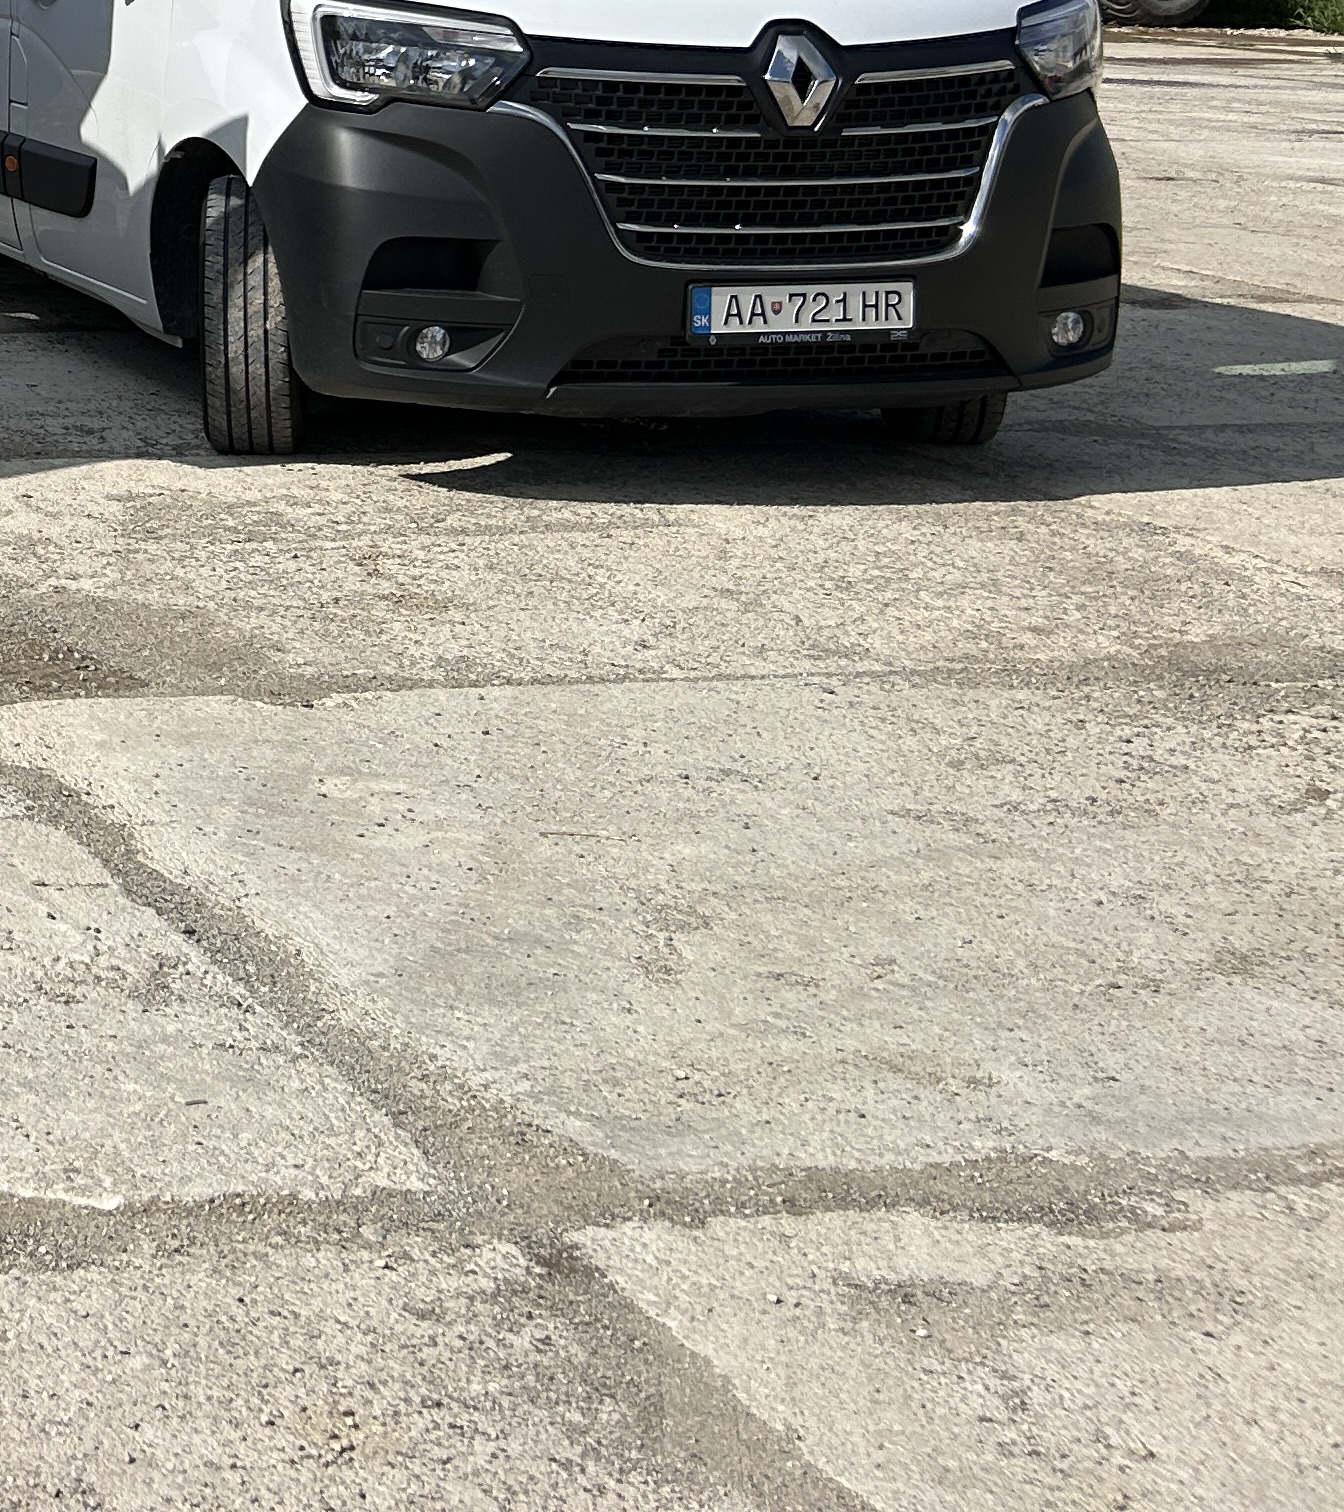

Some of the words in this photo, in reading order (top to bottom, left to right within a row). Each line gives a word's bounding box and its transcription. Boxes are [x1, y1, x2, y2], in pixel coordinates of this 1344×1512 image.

[693, 315, 710, 327] SK
[758, 335, 784, 343] AUTO
[785, 333, 822, 342] MARKET
